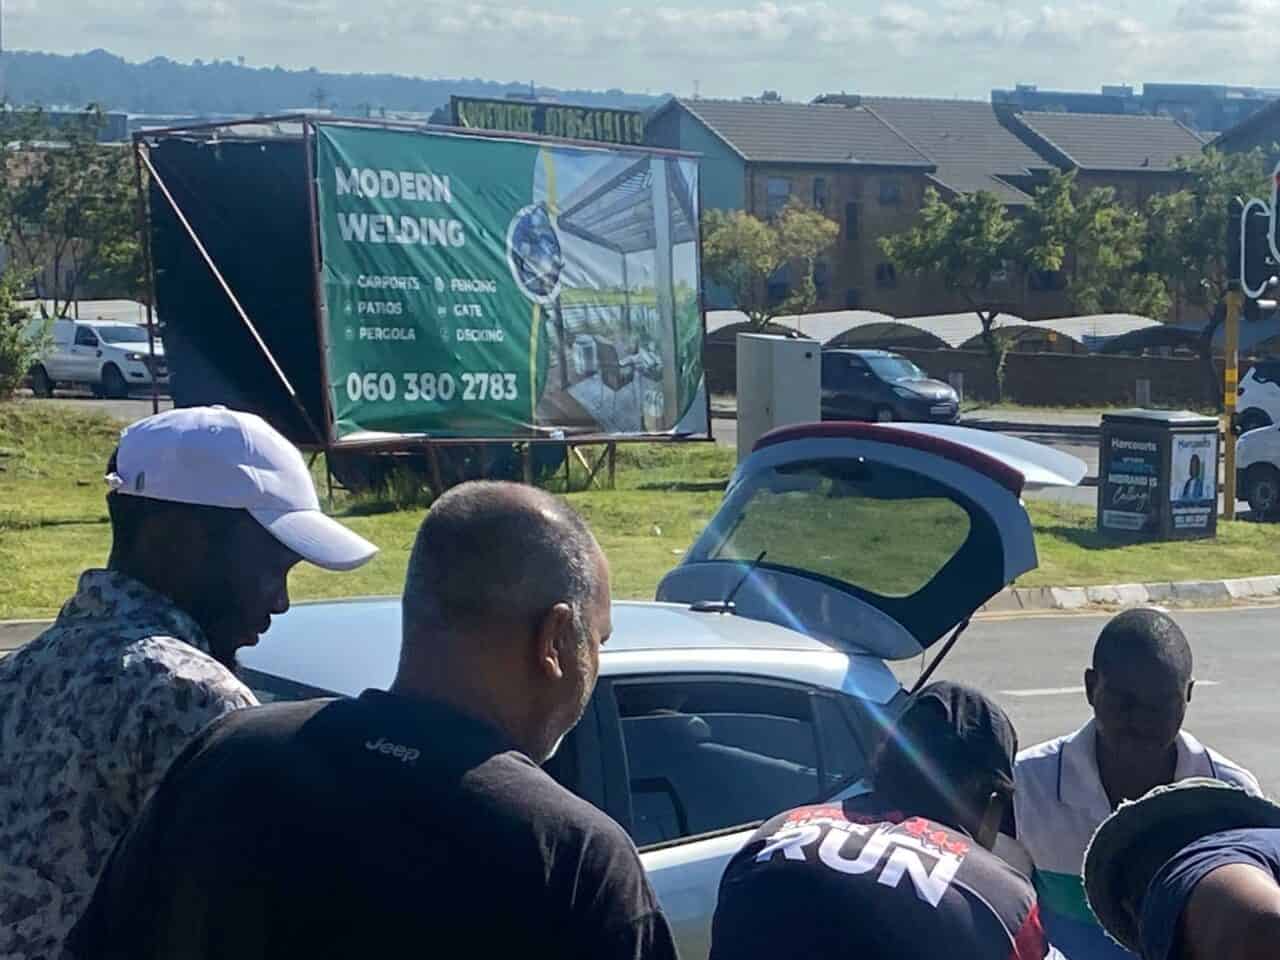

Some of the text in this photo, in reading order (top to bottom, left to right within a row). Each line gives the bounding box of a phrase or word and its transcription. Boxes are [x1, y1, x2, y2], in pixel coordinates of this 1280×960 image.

[335, 166, 451, 203] MODERN
[337, 212, 465, 248] WELDING
[357, 275, 497, 293] CARPORTS FENCING
[358, 301, 403, 315] PATIOS
[359, 328, 505, 342] PERGOLA DECKING
[346, 372, 519, 401] 060 380 2783
[365, 738, 420, 762] Jeep
[755, 815, 968, 908] RUN
